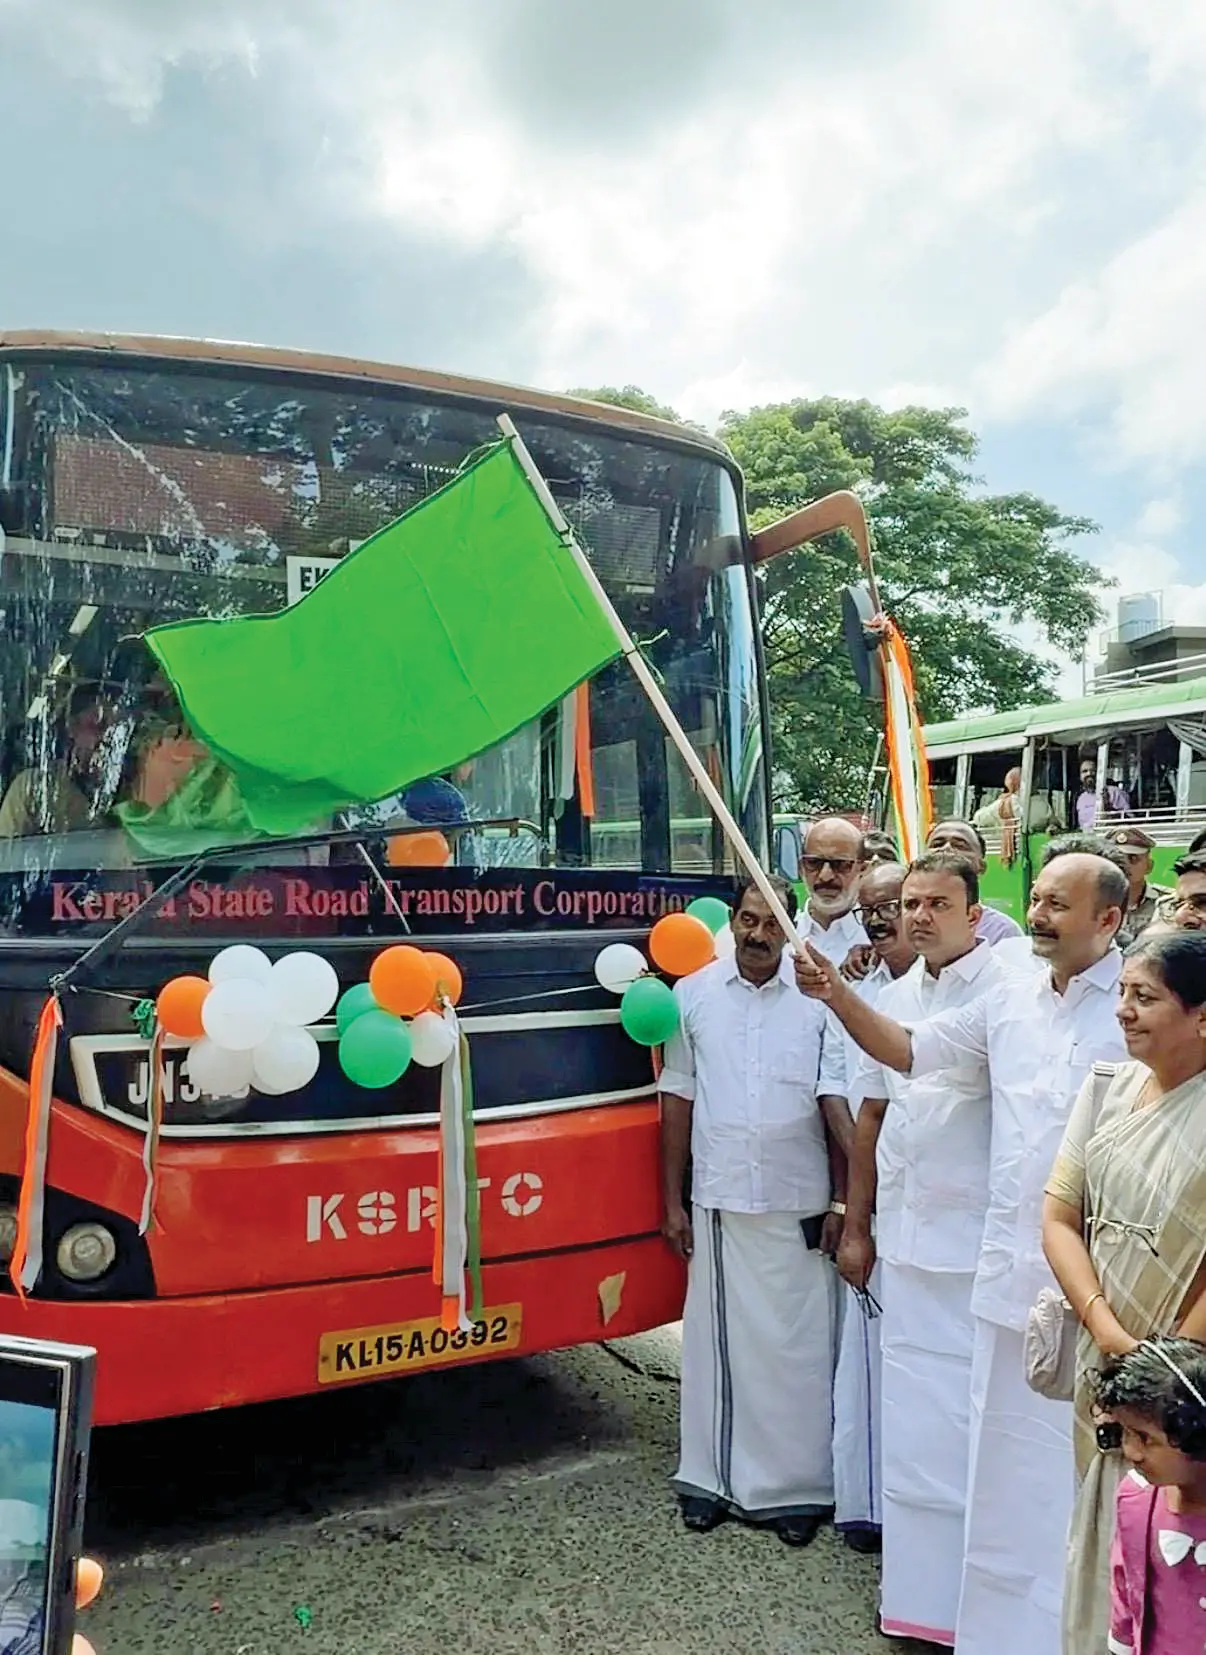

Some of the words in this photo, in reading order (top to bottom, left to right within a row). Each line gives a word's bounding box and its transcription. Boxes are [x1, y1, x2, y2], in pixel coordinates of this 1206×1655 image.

[188, 880, 273, 918] State
[285, 879, 367, 917] Road
[379, 879, 526, 924] Transport
[128, 1060, 251, 1104] JN3
